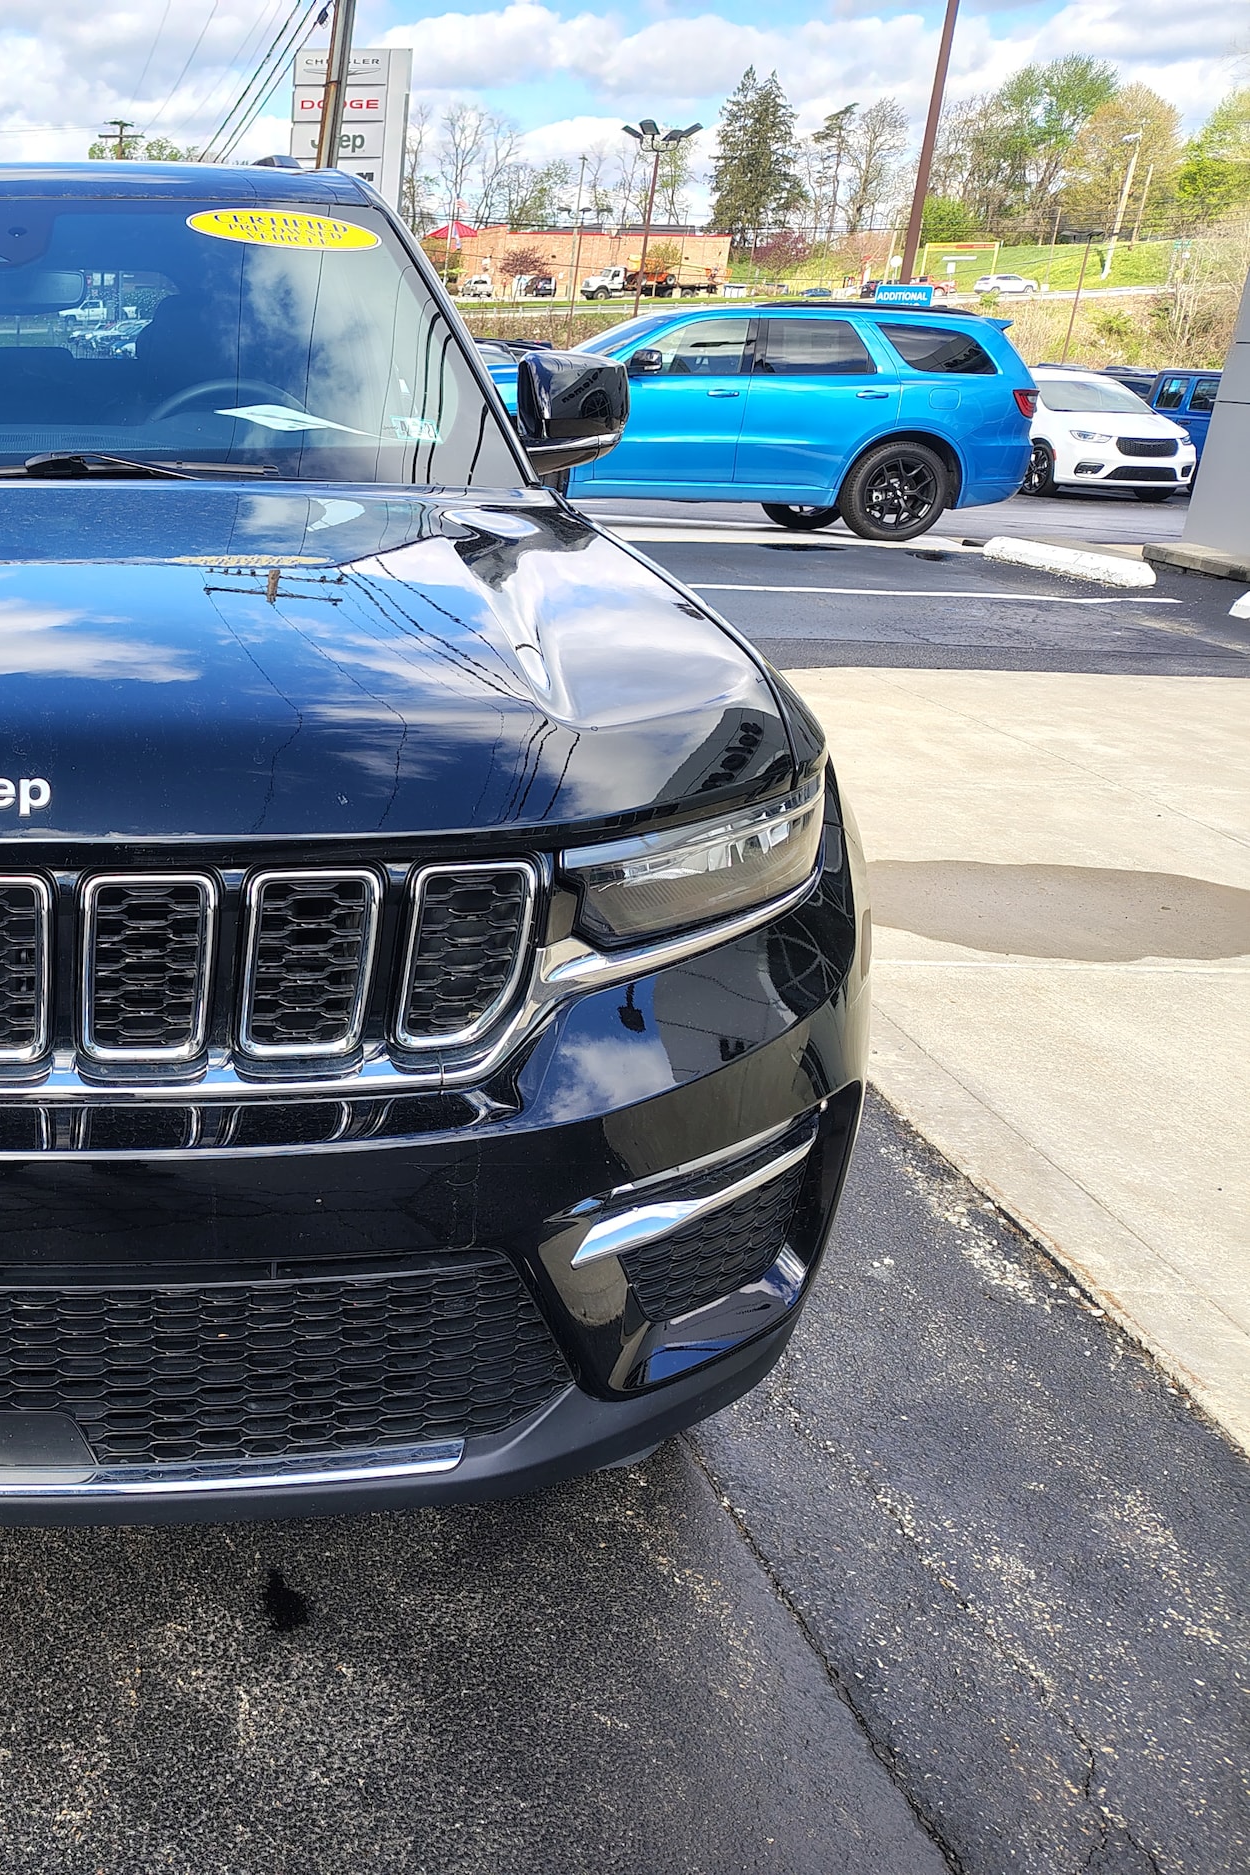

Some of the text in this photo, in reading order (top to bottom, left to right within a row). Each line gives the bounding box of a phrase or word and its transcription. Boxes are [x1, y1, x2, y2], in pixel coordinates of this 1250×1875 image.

[214, 214, 349, 234] CERTIFIED
[228, 223, 343, 240] PRE-OWNED
[246, 231, 330, 245] VEHICLE
[877, 291, 928, 301] ADDITIONAL
